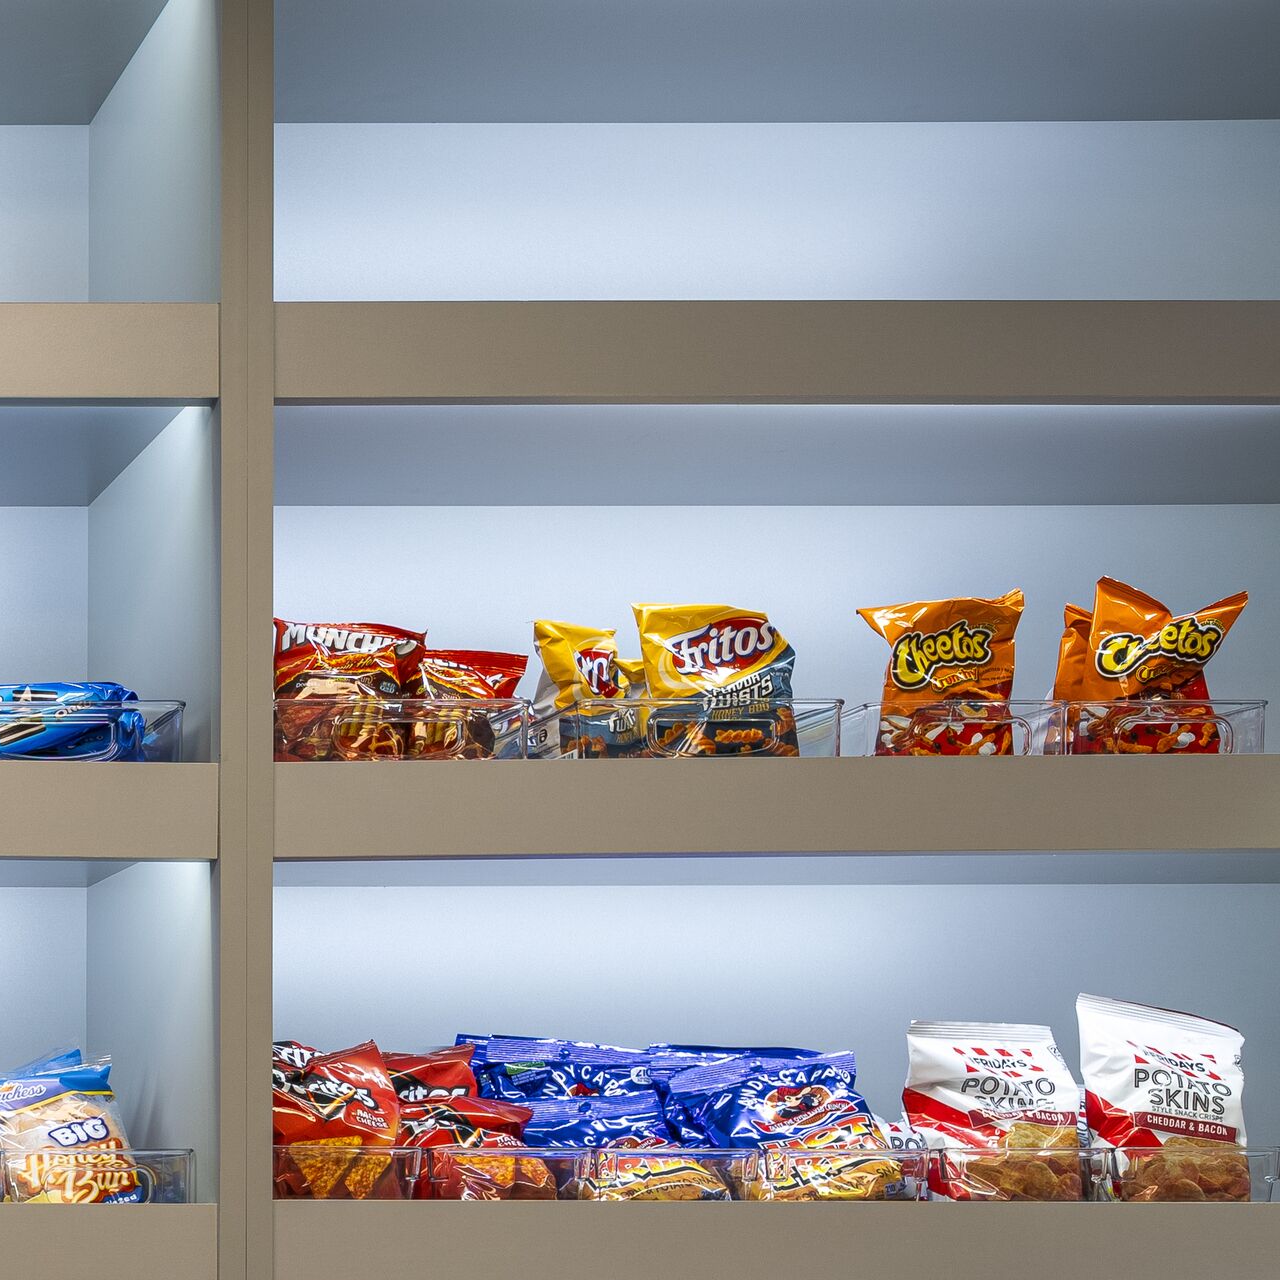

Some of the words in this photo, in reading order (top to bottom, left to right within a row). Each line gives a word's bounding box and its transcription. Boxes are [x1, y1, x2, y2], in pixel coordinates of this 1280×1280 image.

[665, 621, 776, 674] Fritos
[892, 625, 990, 689] Cheetos
[1097, 621, 1221, 676] Cheetos
[931, 668, 979, 692] Crunchy
[711, 706, 747, 720] HONEY
[748, 702, 770, 714] BBQ
[961, 1076, 1056, 1096] POTATO
[1134, 1068, 1232, 1098] POTATO
[1149, 1088, 1226, 1115] SKINS
[356, 1109, 385, 1123] NACHO
[356, 1116, 389, 1128] CHEESE
[1035, 1111, 1065, 1122] BACON
[1147, 1114, 1187, 1129] CHEDDAR
[1188, 1121, 1195, 1130] &
[1196, 1122, 1228, 1136] BACON
[1151, 1105, 1174, 1114] STYLE
[1175, 1108, 1198, 1119] SNACK
[1198, 1111, 1224, 1122] CRISPS
[51, 1118, 107, 1146] BIG
